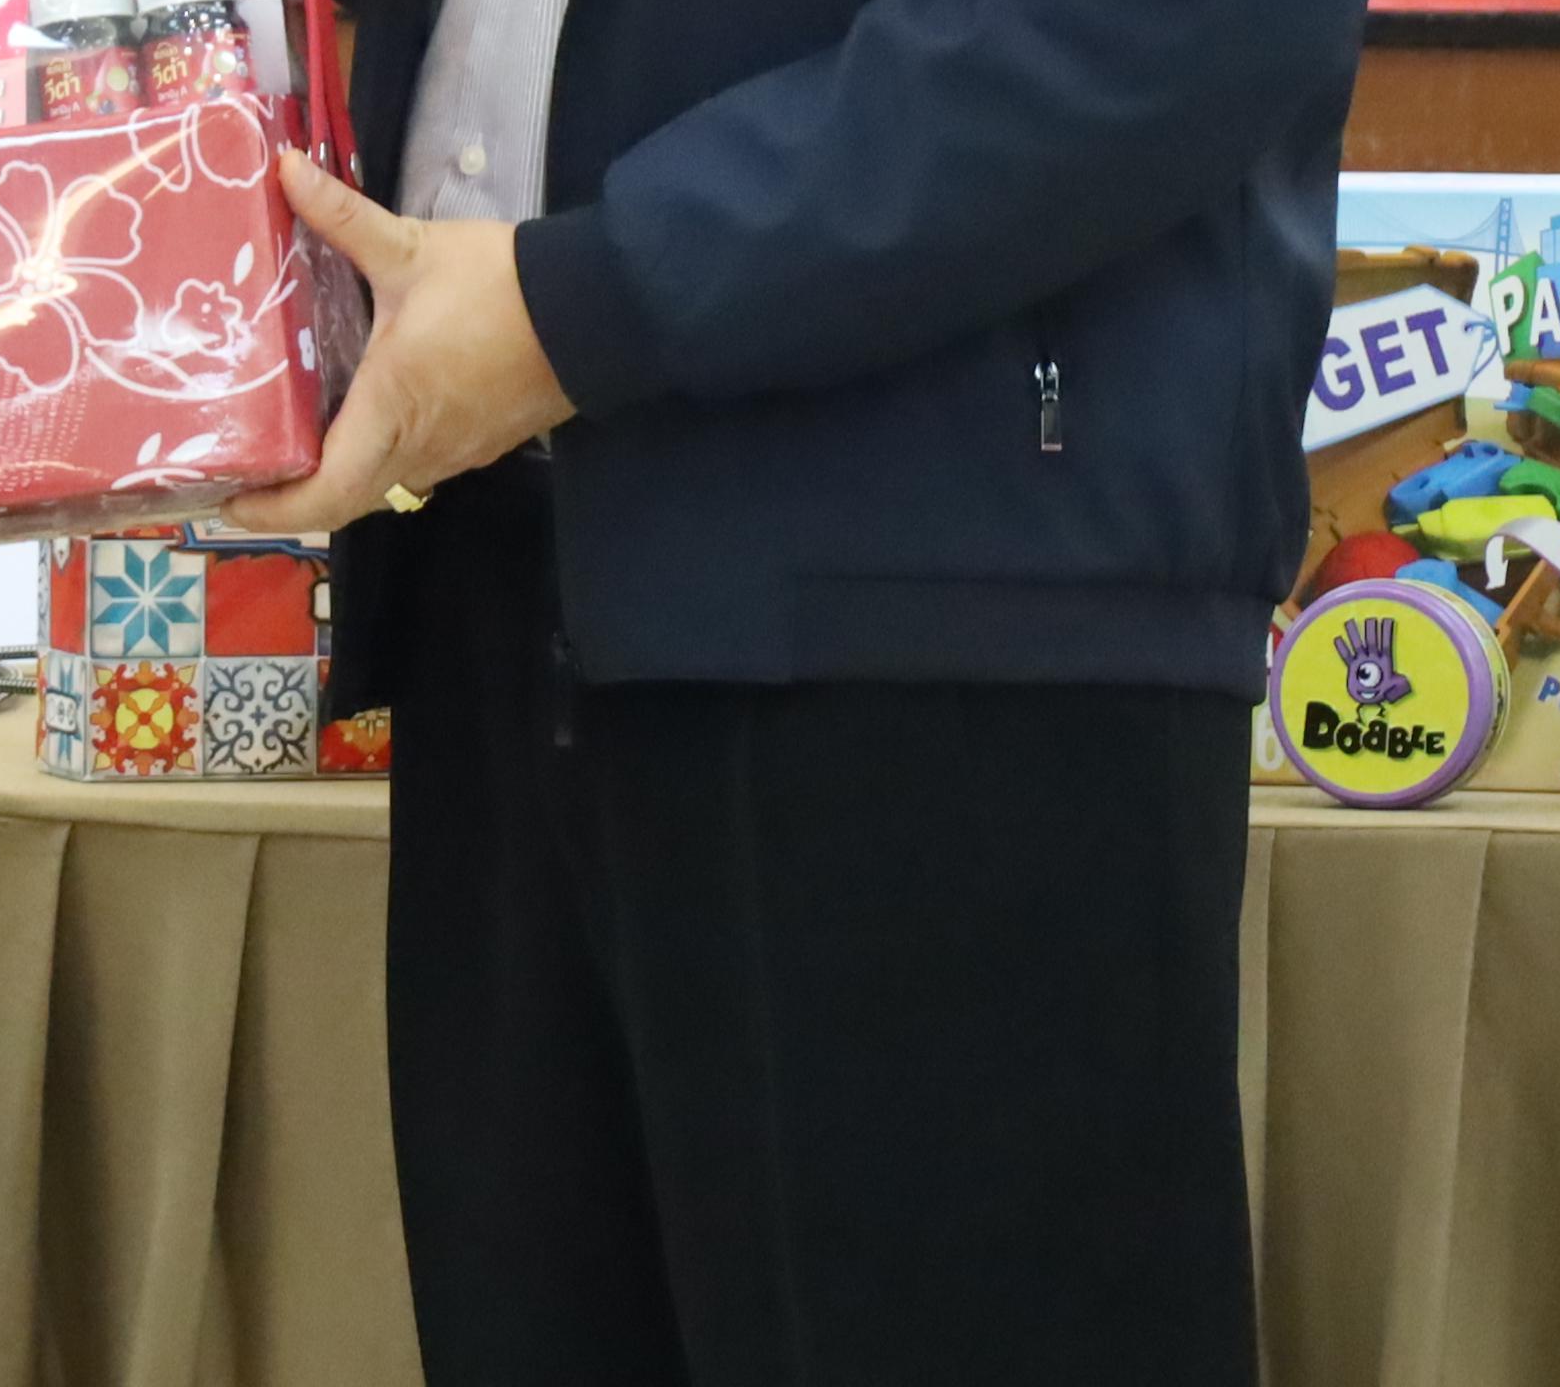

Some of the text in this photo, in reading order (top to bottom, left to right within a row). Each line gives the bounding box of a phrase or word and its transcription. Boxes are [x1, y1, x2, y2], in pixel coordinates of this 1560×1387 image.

[45, 72, 81, 104] วีต้า
[152, 56, 189, 90] วีต้า
[1312, 308, 1450, 411] GET
